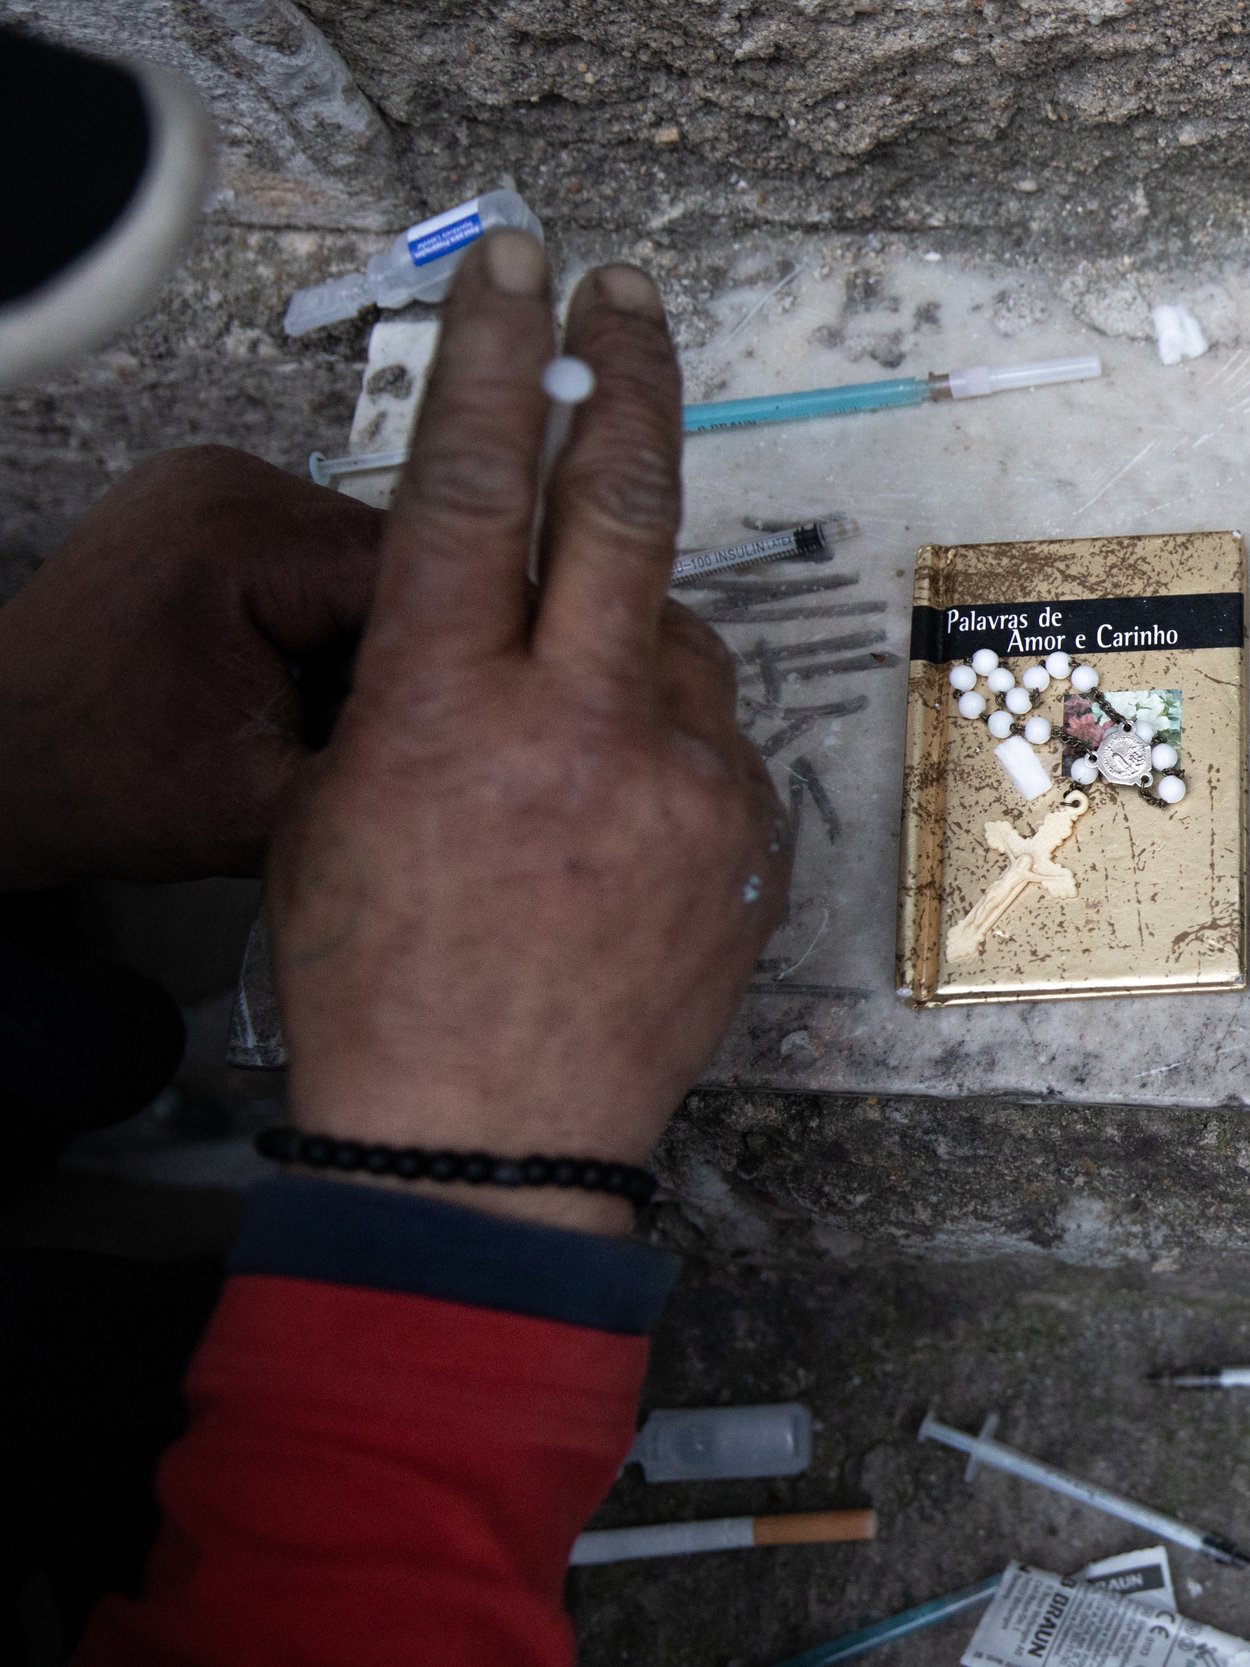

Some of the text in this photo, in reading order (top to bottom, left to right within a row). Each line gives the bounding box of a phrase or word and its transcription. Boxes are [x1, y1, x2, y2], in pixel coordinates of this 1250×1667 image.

[715, 542, 766, 564] INSULIN
[947, 607, 1062, 634] Palavras de
[1007, 624, 1178, 652] Amor e Carinho
[1027, 1592, 1070, 1660] BRAUN
